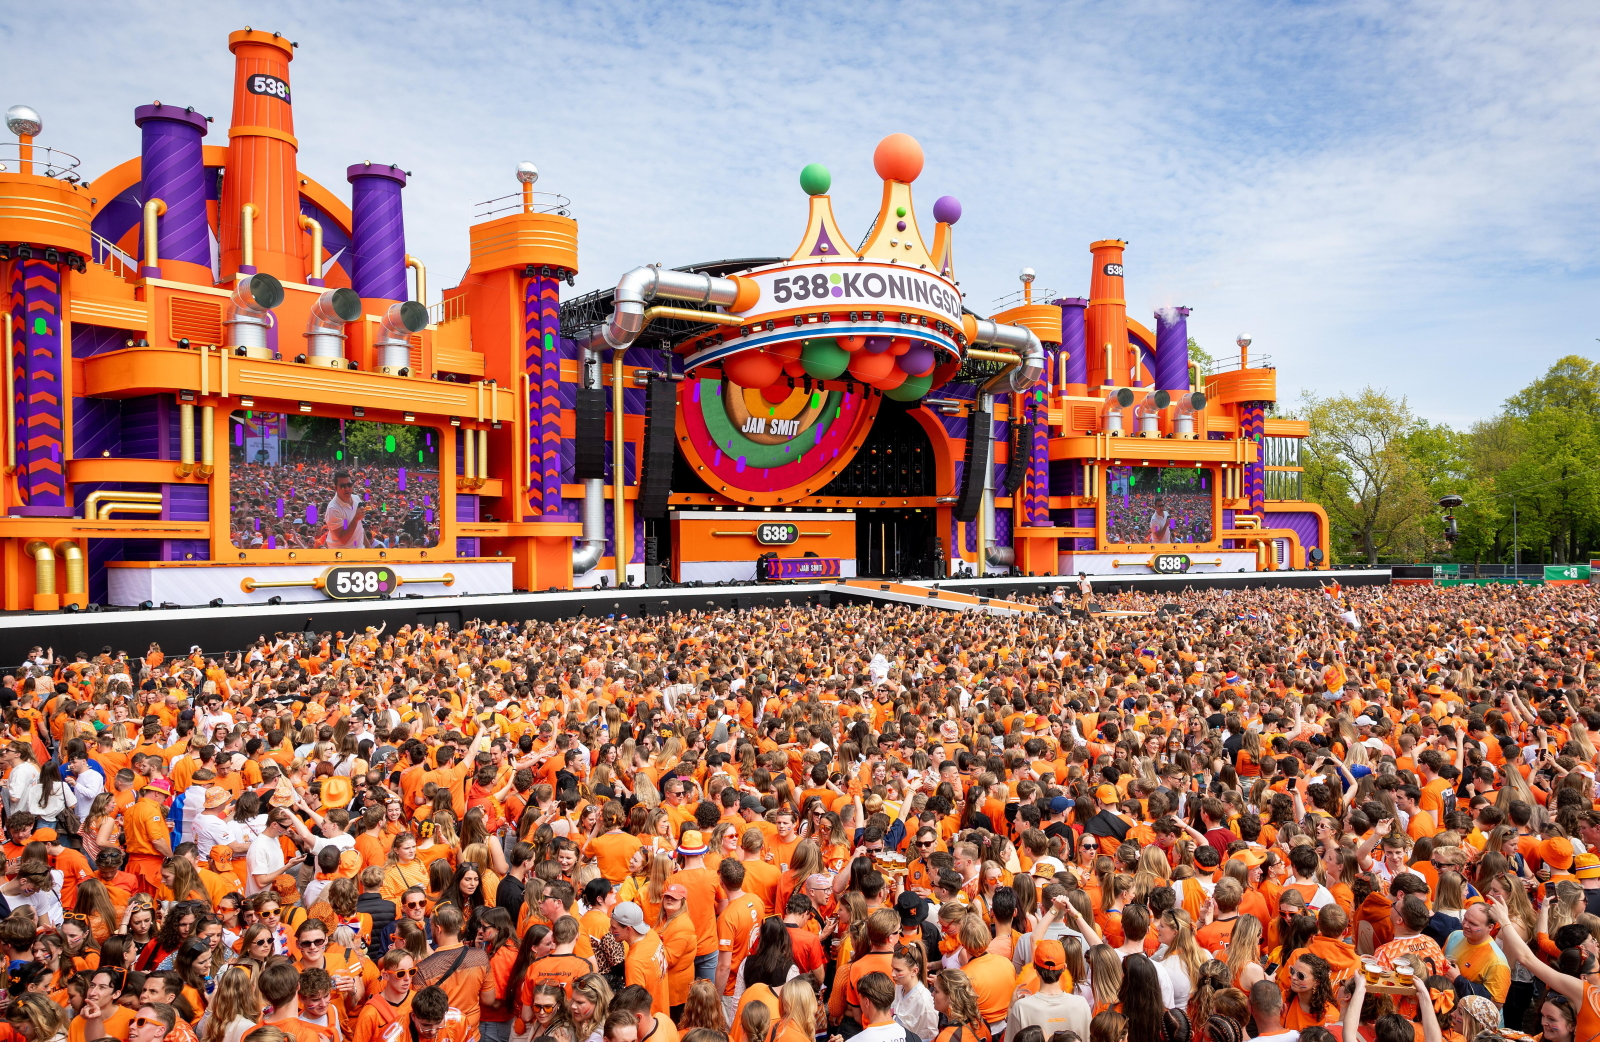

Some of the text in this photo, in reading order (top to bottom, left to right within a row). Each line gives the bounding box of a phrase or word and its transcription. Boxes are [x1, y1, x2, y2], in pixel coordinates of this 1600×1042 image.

[254, 76, 285, 98] 538
[1107, 265, 1122, 276] 538
[742, 417, 800, 435] JAN SMIT
[763, 526, 788, 541] 538
[1159, 557, 1180, 570] 538
[336, 571, 378, 593] 538
